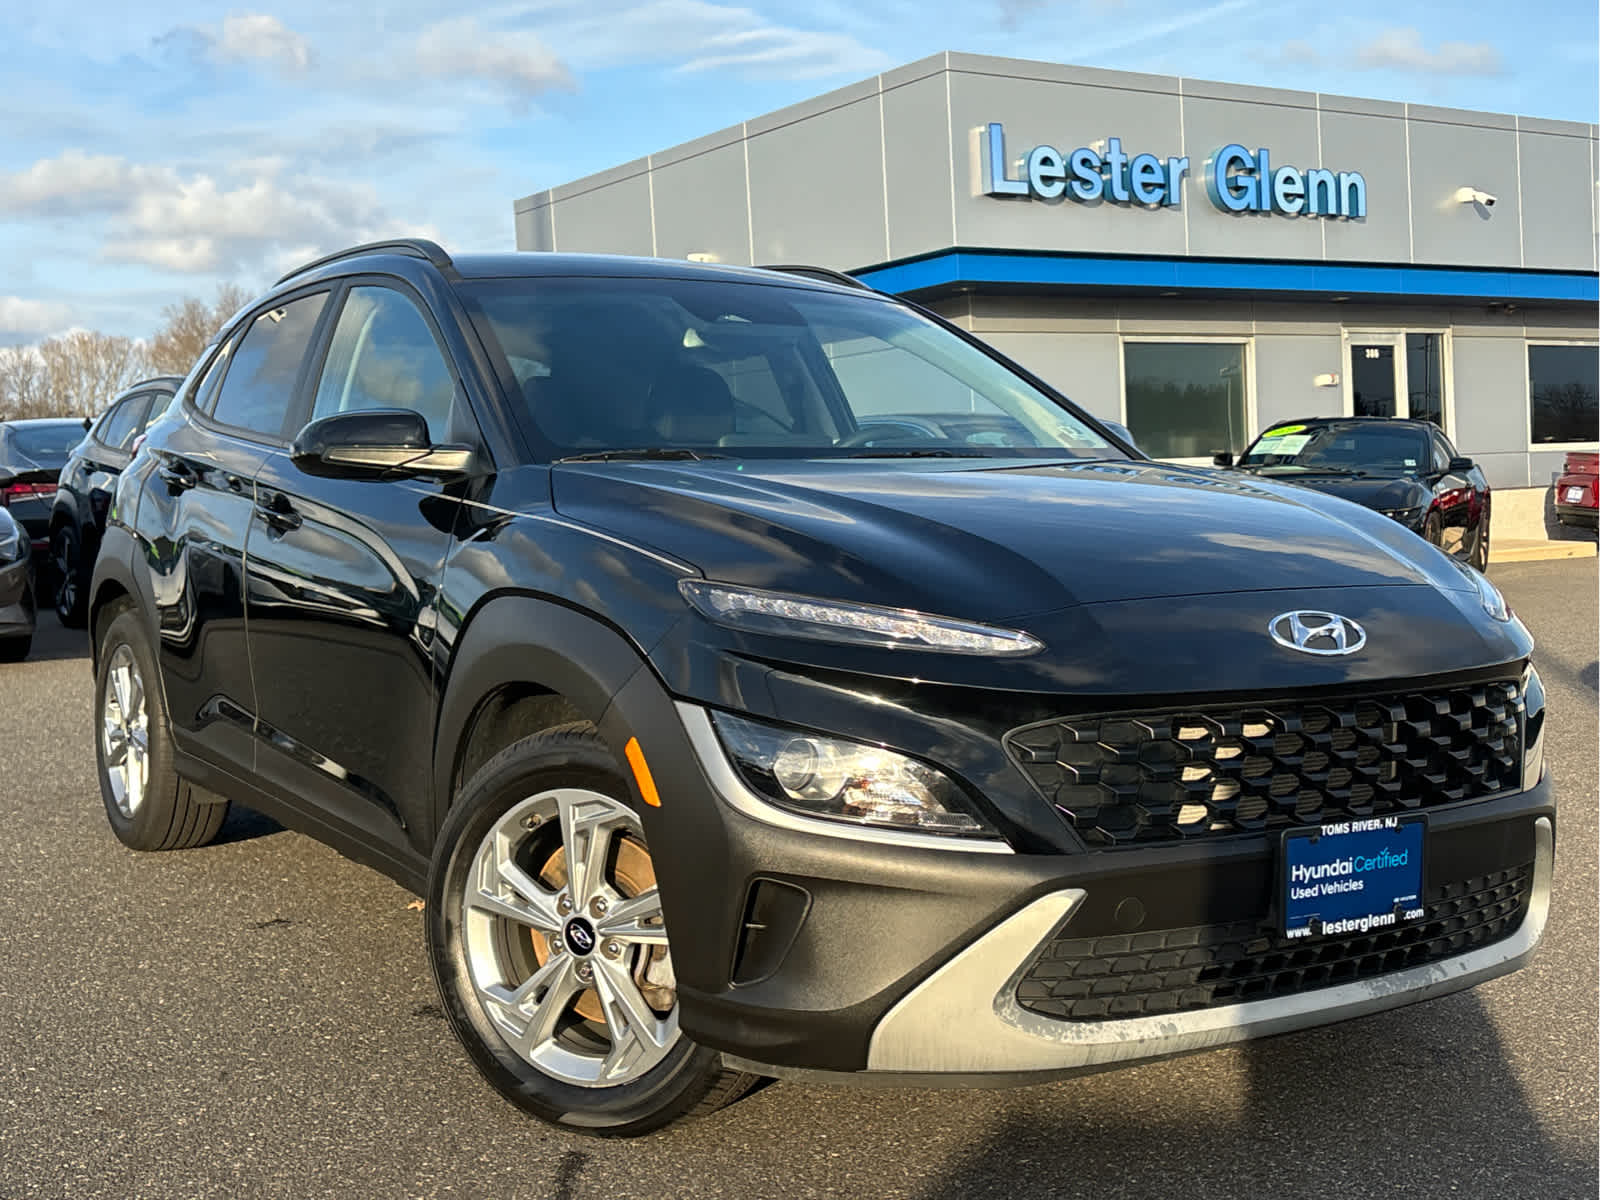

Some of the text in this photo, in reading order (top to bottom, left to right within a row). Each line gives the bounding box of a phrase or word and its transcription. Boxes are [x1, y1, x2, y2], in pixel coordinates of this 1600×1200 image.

[984, 122, 1367, 218] Lester Glenn
[1321, 823, 1350, 837] TOMS
[1385, 816, 1399, 829] NJ
[1291, 848, 1409, 884] Hyundai Certified
[1291, 879, 1364, 900] Used Vehicles
[1322, 913, 1396, 936] lesterglenn
